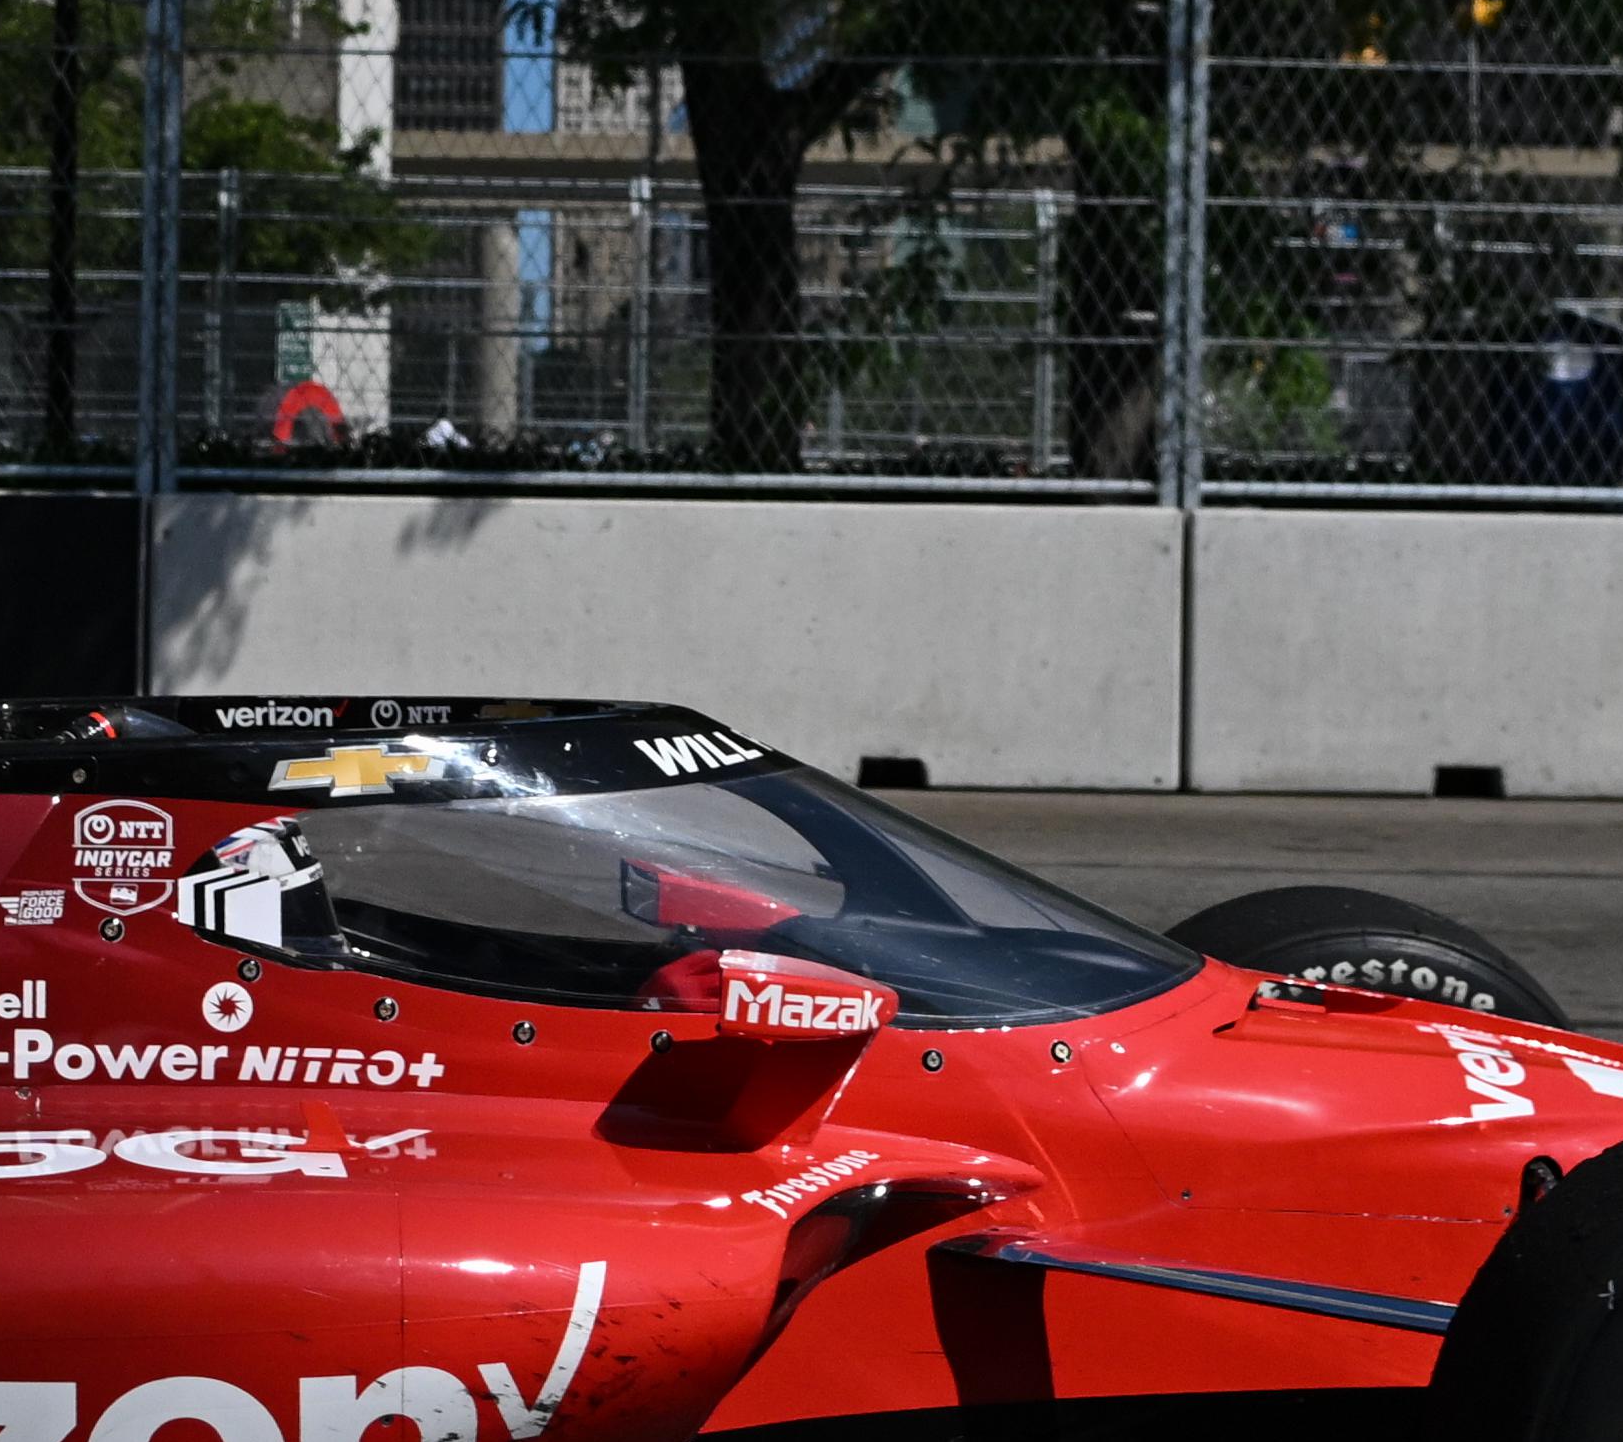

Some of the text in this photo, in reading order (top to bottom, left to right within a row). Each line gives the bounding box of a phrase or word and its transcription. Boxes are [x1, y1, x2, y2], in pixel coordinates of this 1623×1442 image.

[215, 699, 335, 729] verizon
[407, 705, 452, 725] NTT
[632, 729, 765, 777] WILL
[118, 820, 165, 839] NTT
[74, 849, 173, 868] INDYCAR
[94, 867, 151, 878] SERIES
[20, 896, 66, 907] FORCE
[22, 907, 64, 919] GOOD
[723, 978, 885, 1034] Mazak
[741, 1144, 880, 1219] Firestone
